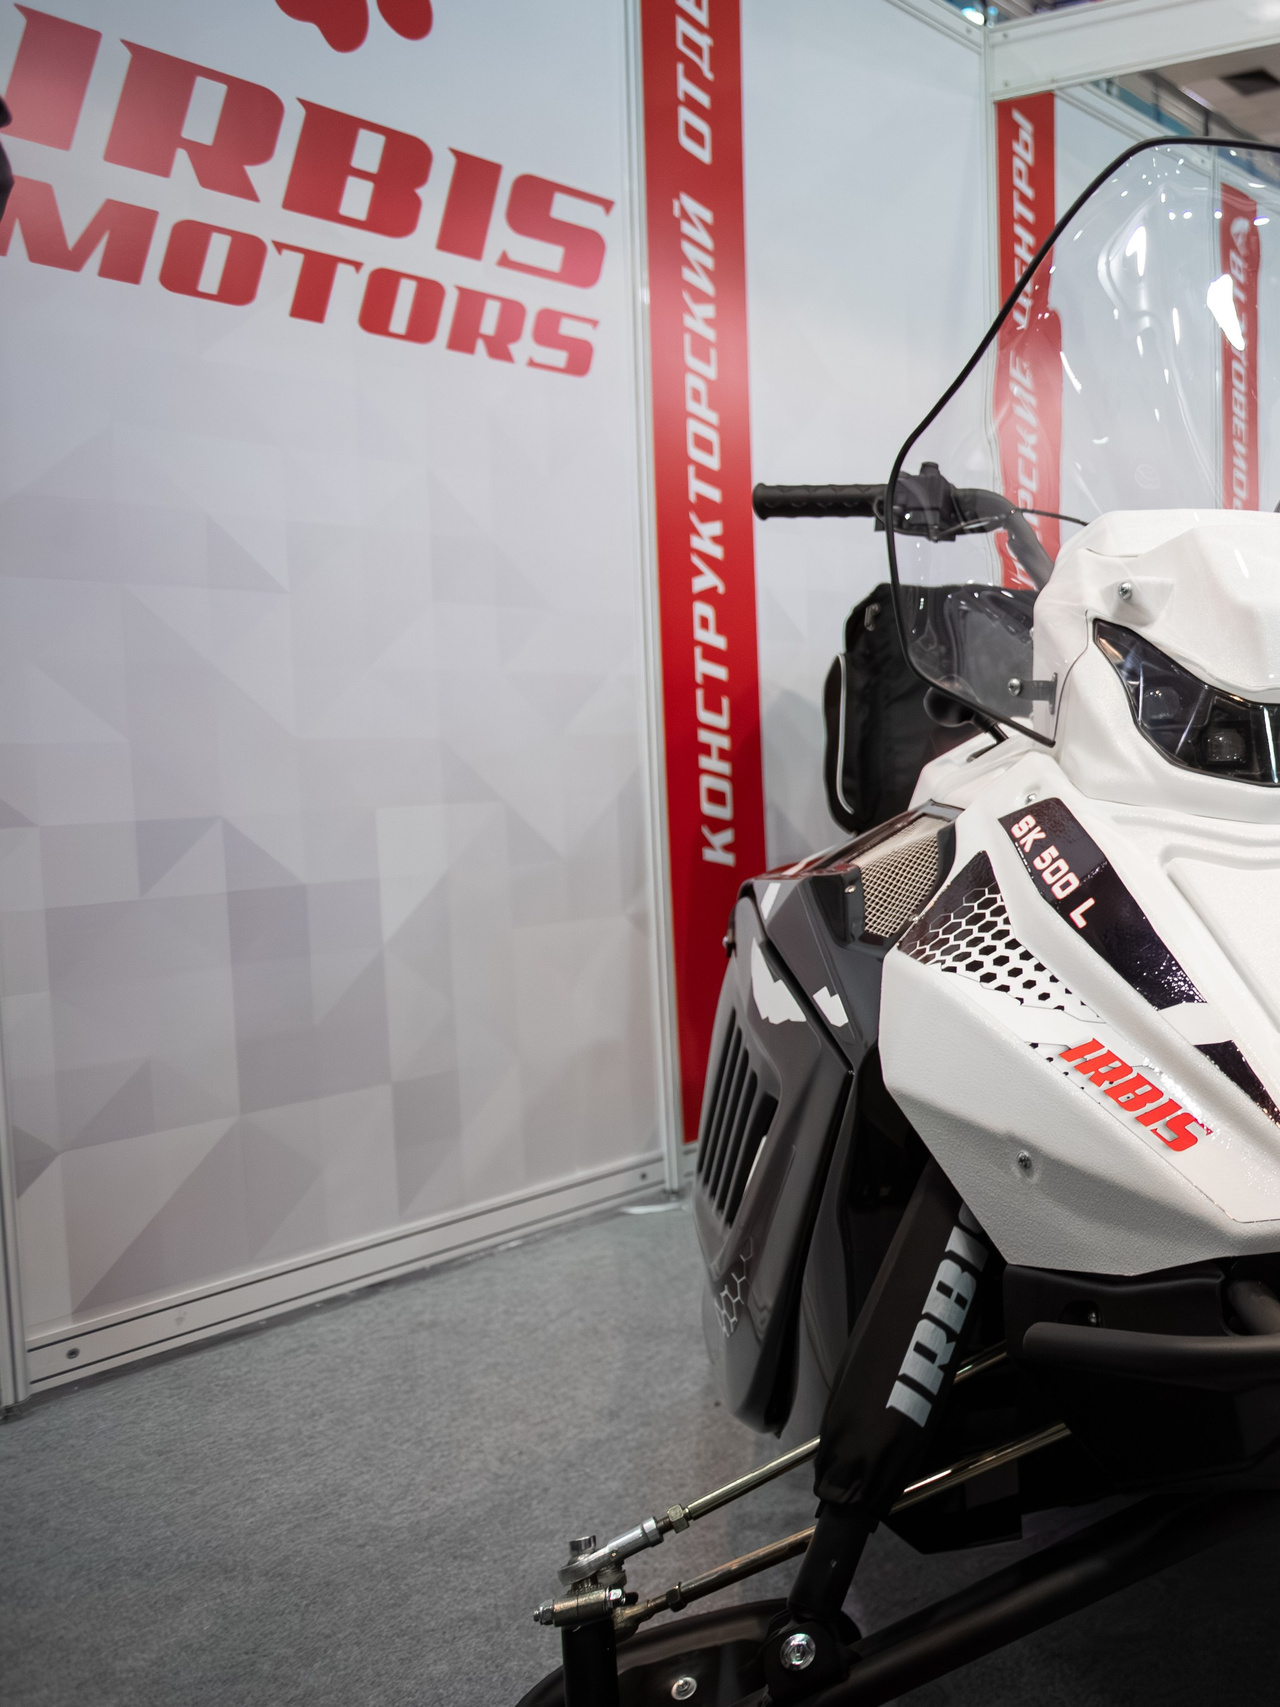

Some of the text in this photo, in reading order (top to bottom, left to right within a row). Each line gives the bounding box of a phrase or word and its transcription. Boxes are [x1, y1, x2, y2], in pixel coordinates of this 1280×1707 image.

[0, 2, 615, 290] IRBIS
[0, 174, 601, 378] MOTORS
[672, 192, 737, 867] КОНСТРУКТОРСКИЙ
[1010, 813, 1096, 929] SK 500 L
[1058, 1037, 1214, 1152] IRBIS
